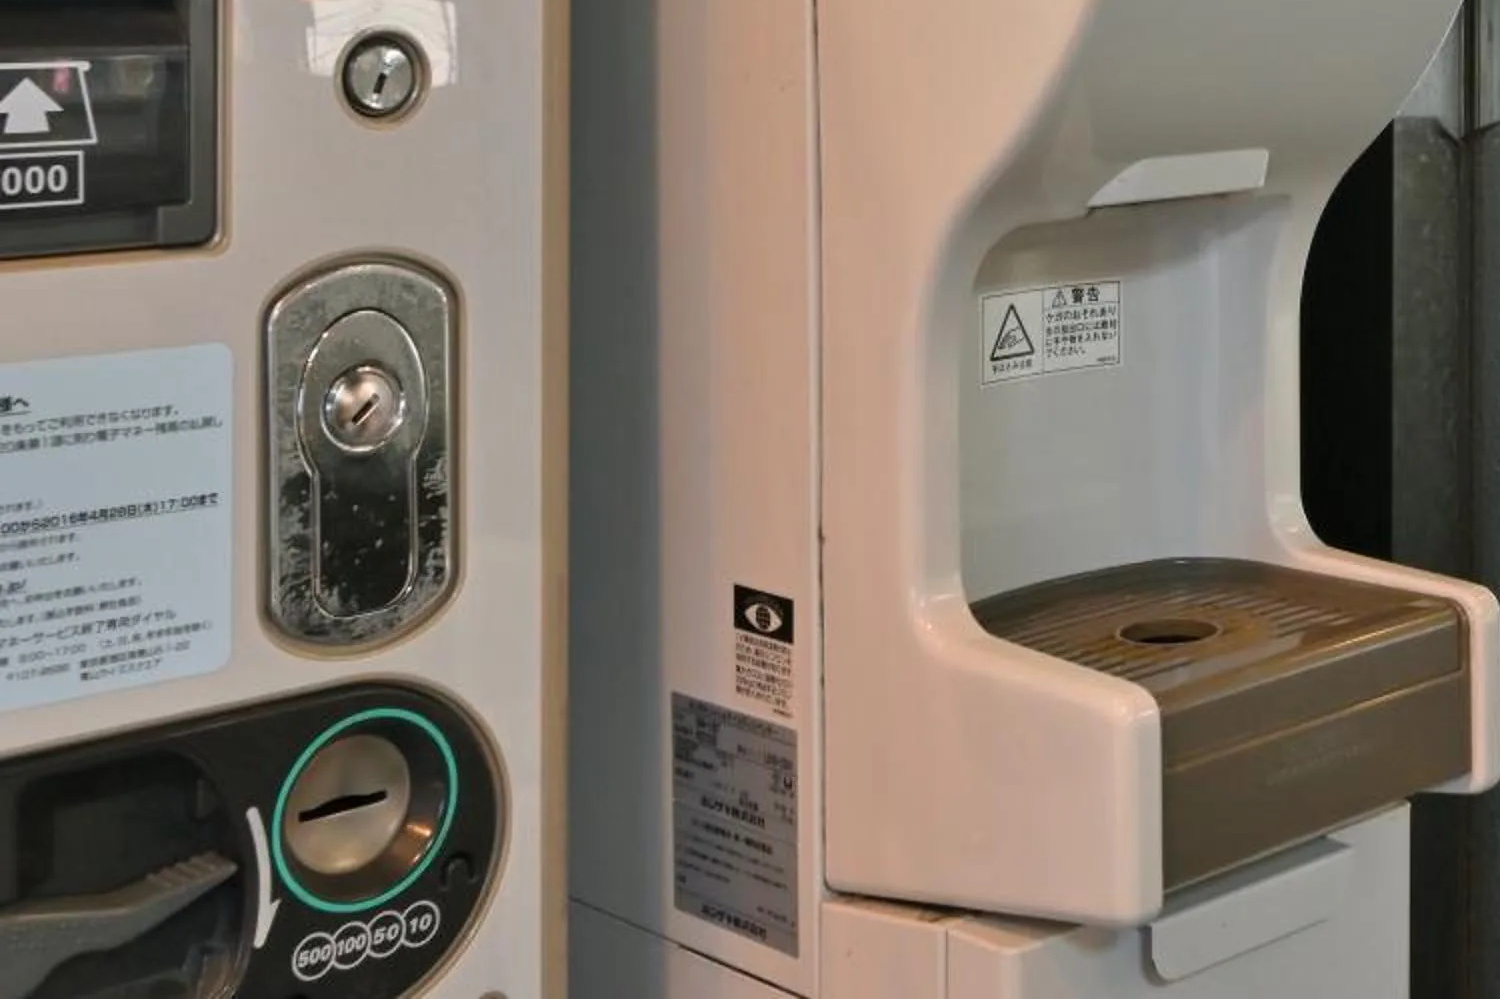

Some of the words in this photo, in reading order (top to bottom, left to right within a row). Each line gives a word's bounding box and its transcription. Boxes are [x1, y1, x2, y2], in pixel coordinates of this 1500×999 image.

[1071, 286, 1100, 304] 警告
[298, 944, 331, 968] 500
[336, 934, 367, 956] 100
[373, 923, 400, 945] 50
[409, 913, 433, 934] 10
